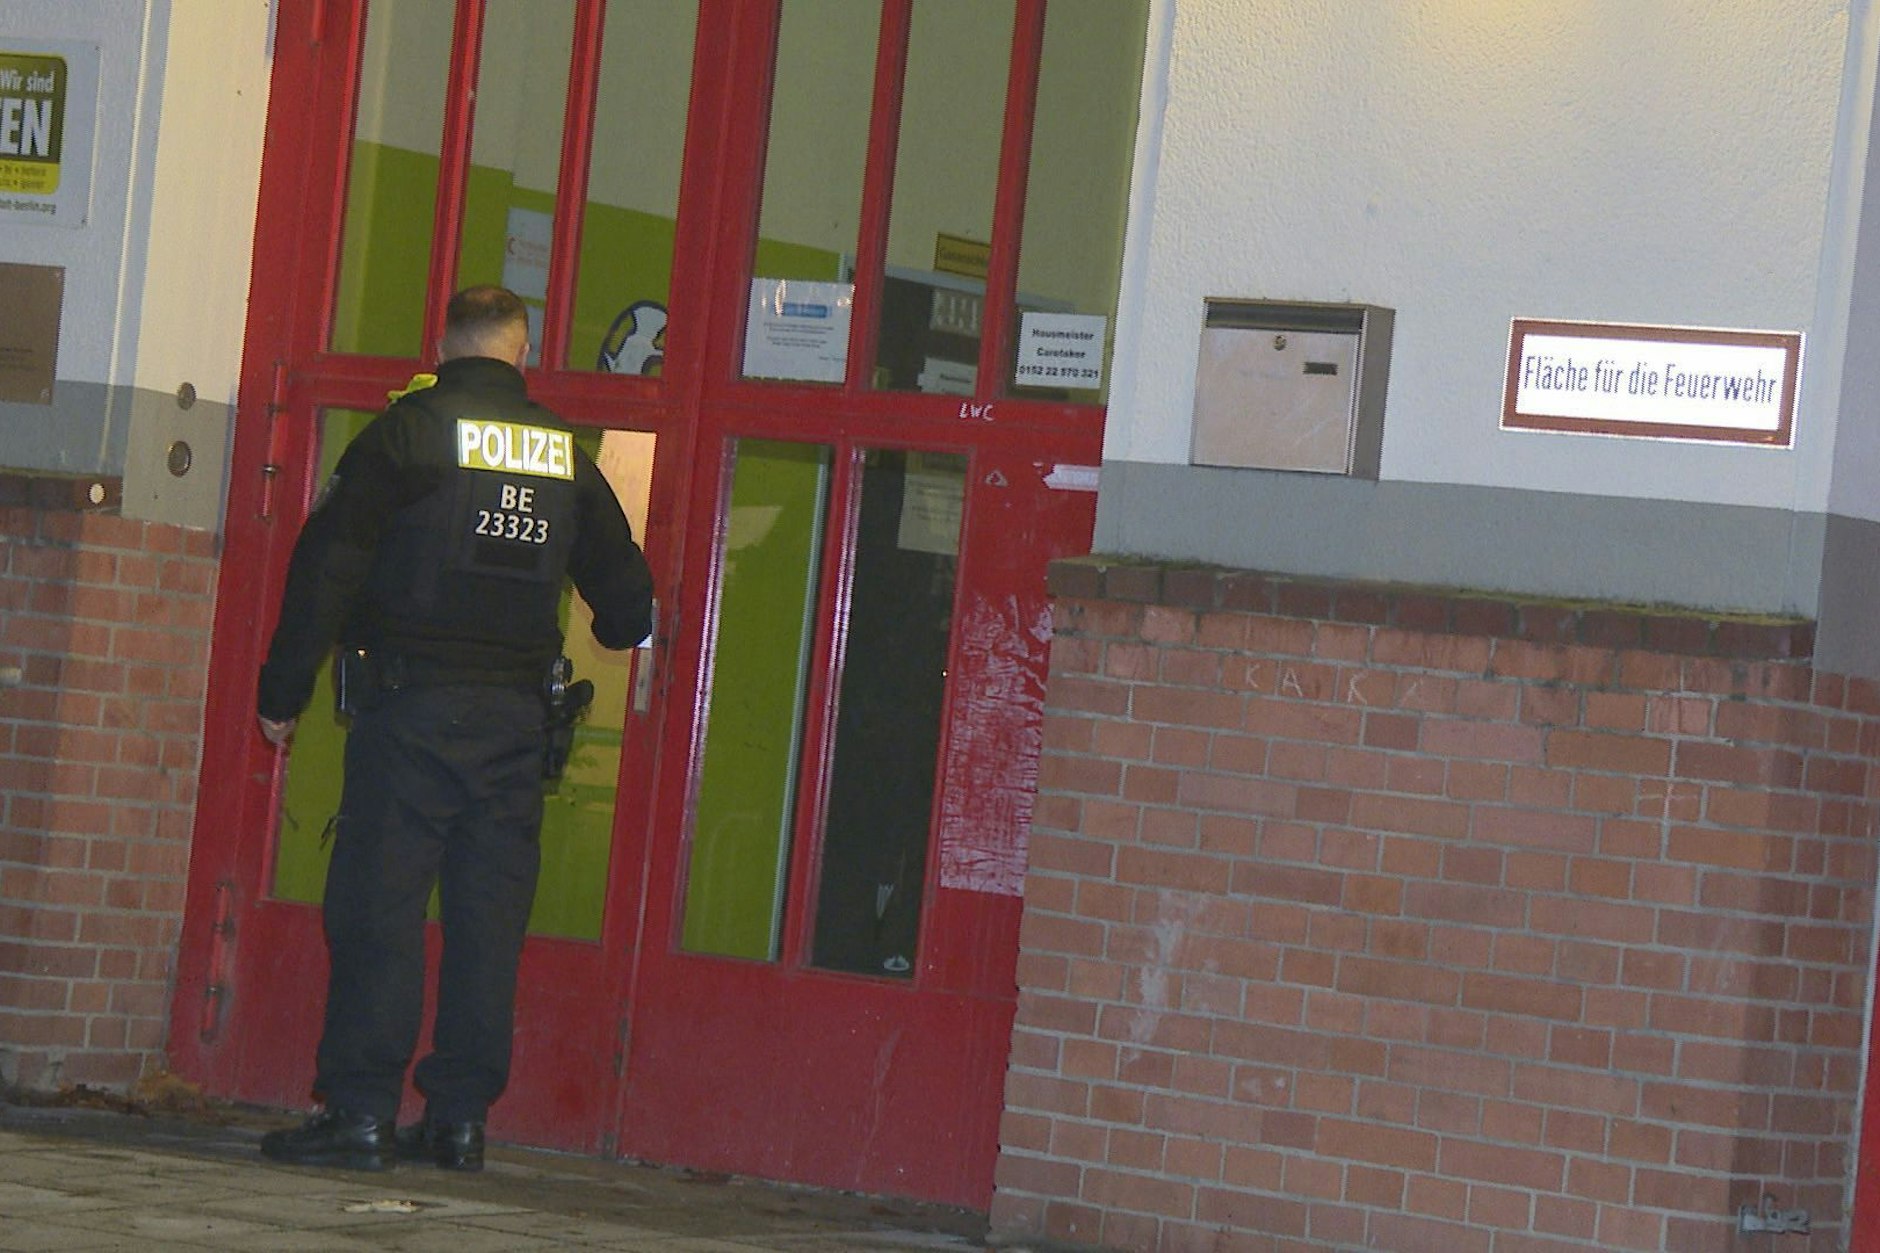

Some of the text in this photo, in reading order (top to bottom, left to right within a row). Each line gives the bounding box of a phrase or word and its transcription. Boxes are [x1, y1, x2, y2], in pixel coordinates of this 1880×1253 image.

[26, 71, 55, 93] sind
[0, 97, 53, 157] EN
[1524, 355, 1777, 404] Fläche für die Feuerwehr
[460, 421, 572, 476] POLIZEI
[500, 484, 535, 513] BE
[475, 510, 549, 544] 23323
